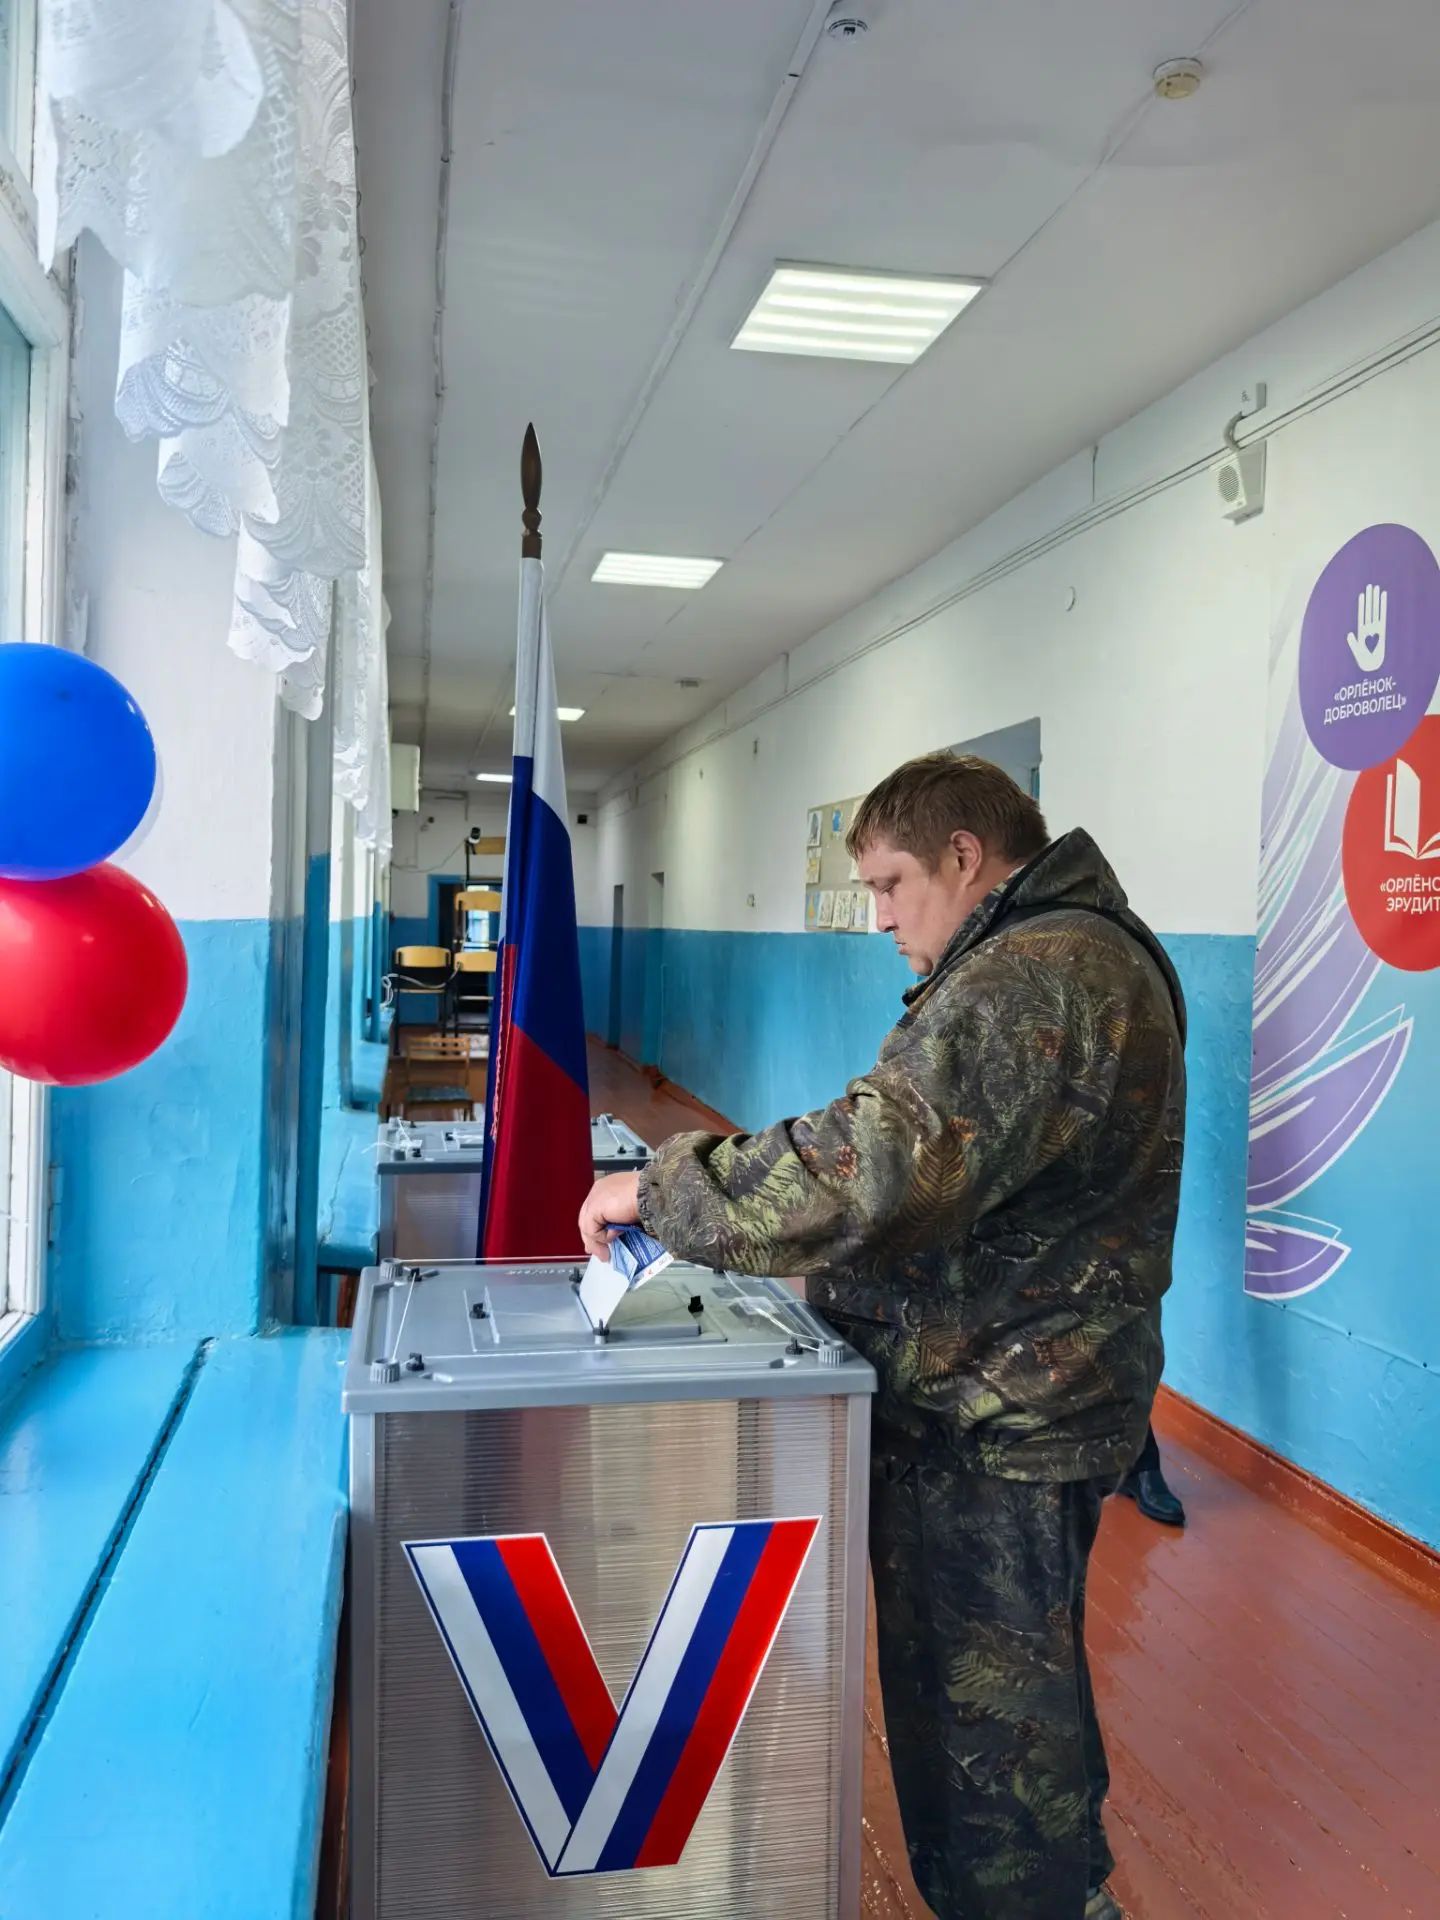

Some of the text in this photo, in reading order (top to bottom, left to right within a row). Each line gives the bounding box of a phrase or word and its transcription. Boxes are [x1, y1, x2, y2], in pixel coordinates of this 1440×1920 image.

[1334, 676, 1397, 702] «ОРЛЁНОК-
[1324, 693, 1407, 726] ДОБРОВОЛЕЦ»
[1386, 895, 1440, 915] ЭРУДИТ
